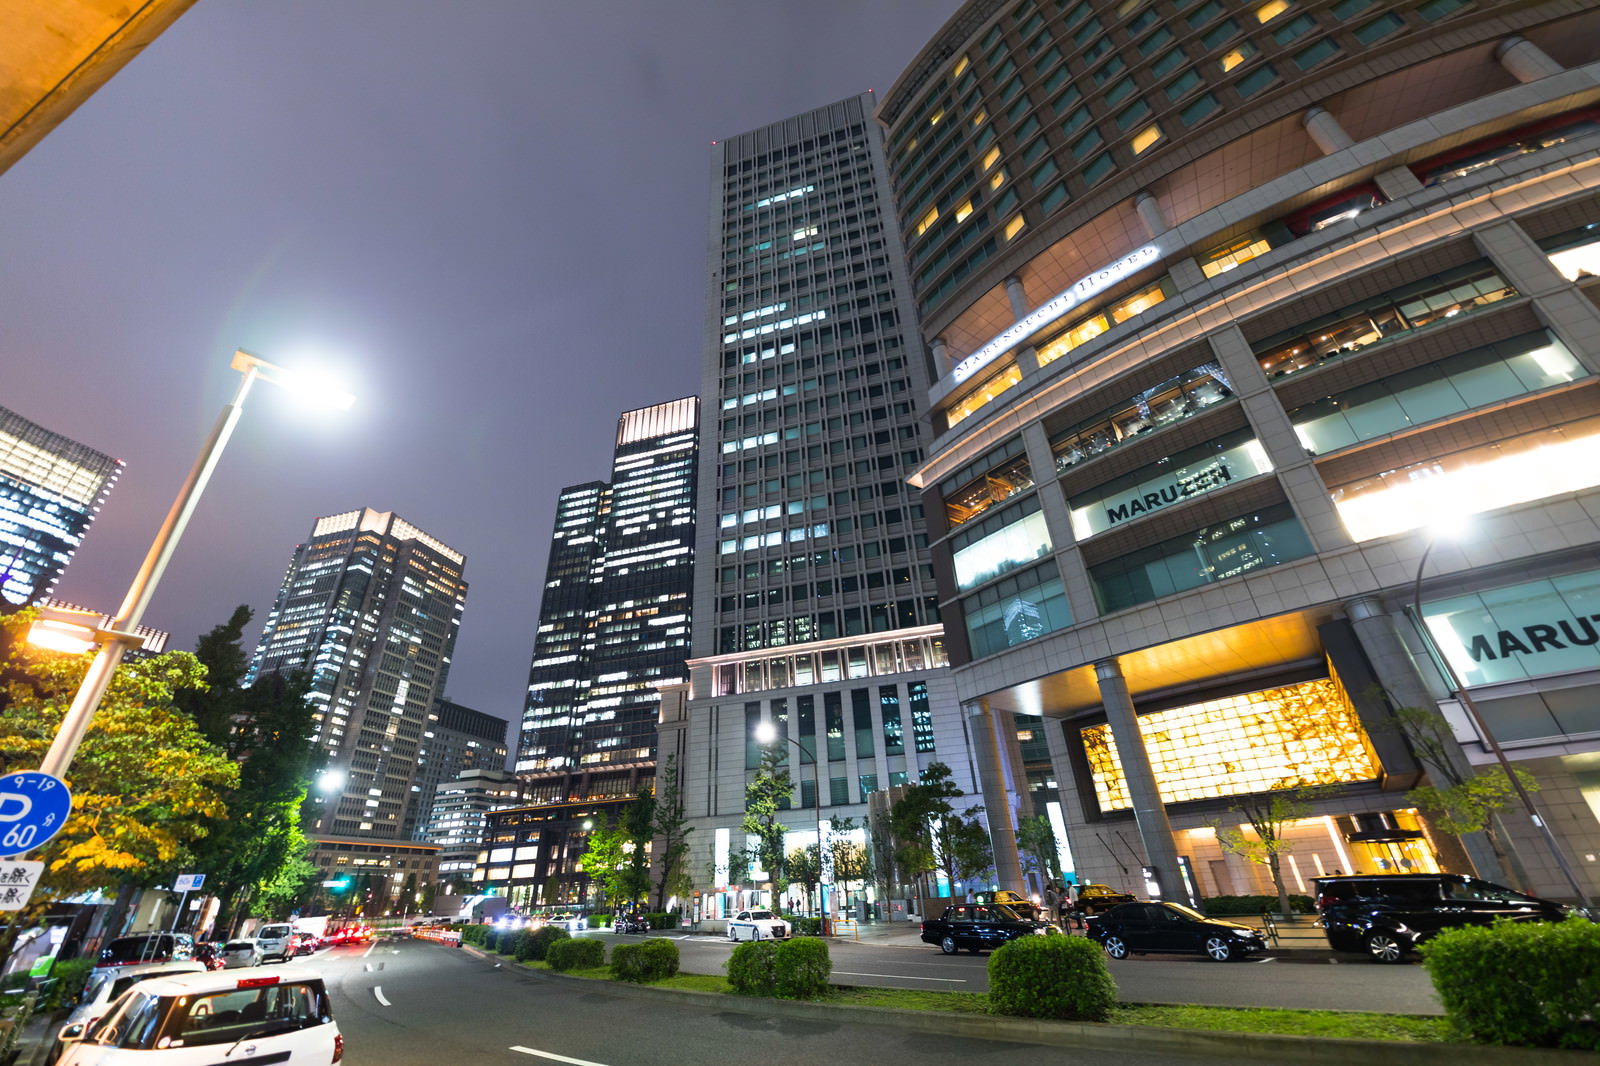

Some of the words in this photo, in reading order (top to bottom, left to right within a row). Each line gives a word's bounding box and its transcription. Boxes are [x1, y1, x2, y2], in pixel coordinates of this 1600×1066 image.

[1079, 248, 1153, 292] HOTEL
[1107, 464, 1232, 524] MARUZEN
[1463, 613, 1600, 663] MARU
[14, 775, 57, 792] 9-19
